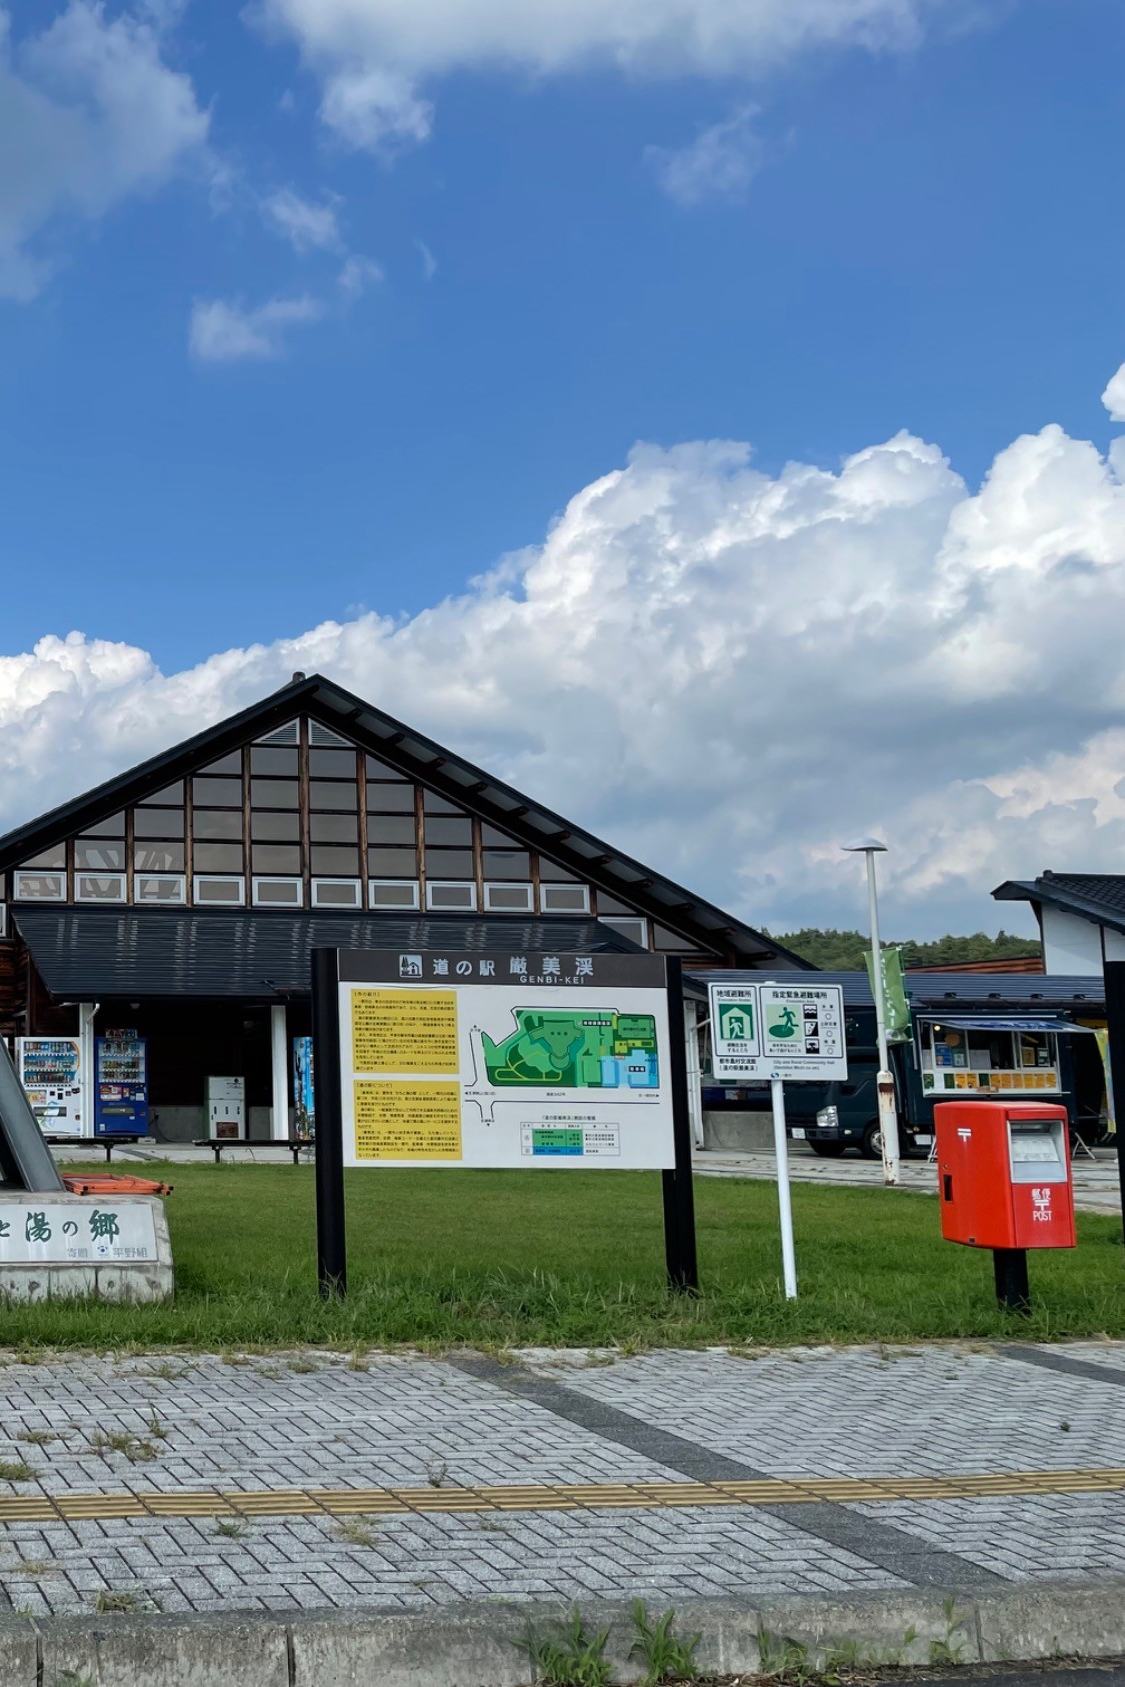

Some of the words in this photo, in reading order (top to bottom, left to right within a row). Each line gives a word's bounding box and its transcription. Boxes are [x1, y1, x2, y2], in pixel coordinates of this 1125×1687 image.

[432, 958, 496, 977] 道の駅
[509, 955, 595, 977] 厳美渓
[519, 975, 585, 985] GENBI-KEI
[772, 990, 827, 1000] 指定緊急避難場所
[1032, 1210, 1053, 1222] POST
[112, 1246, 149, 1258] 平野組
